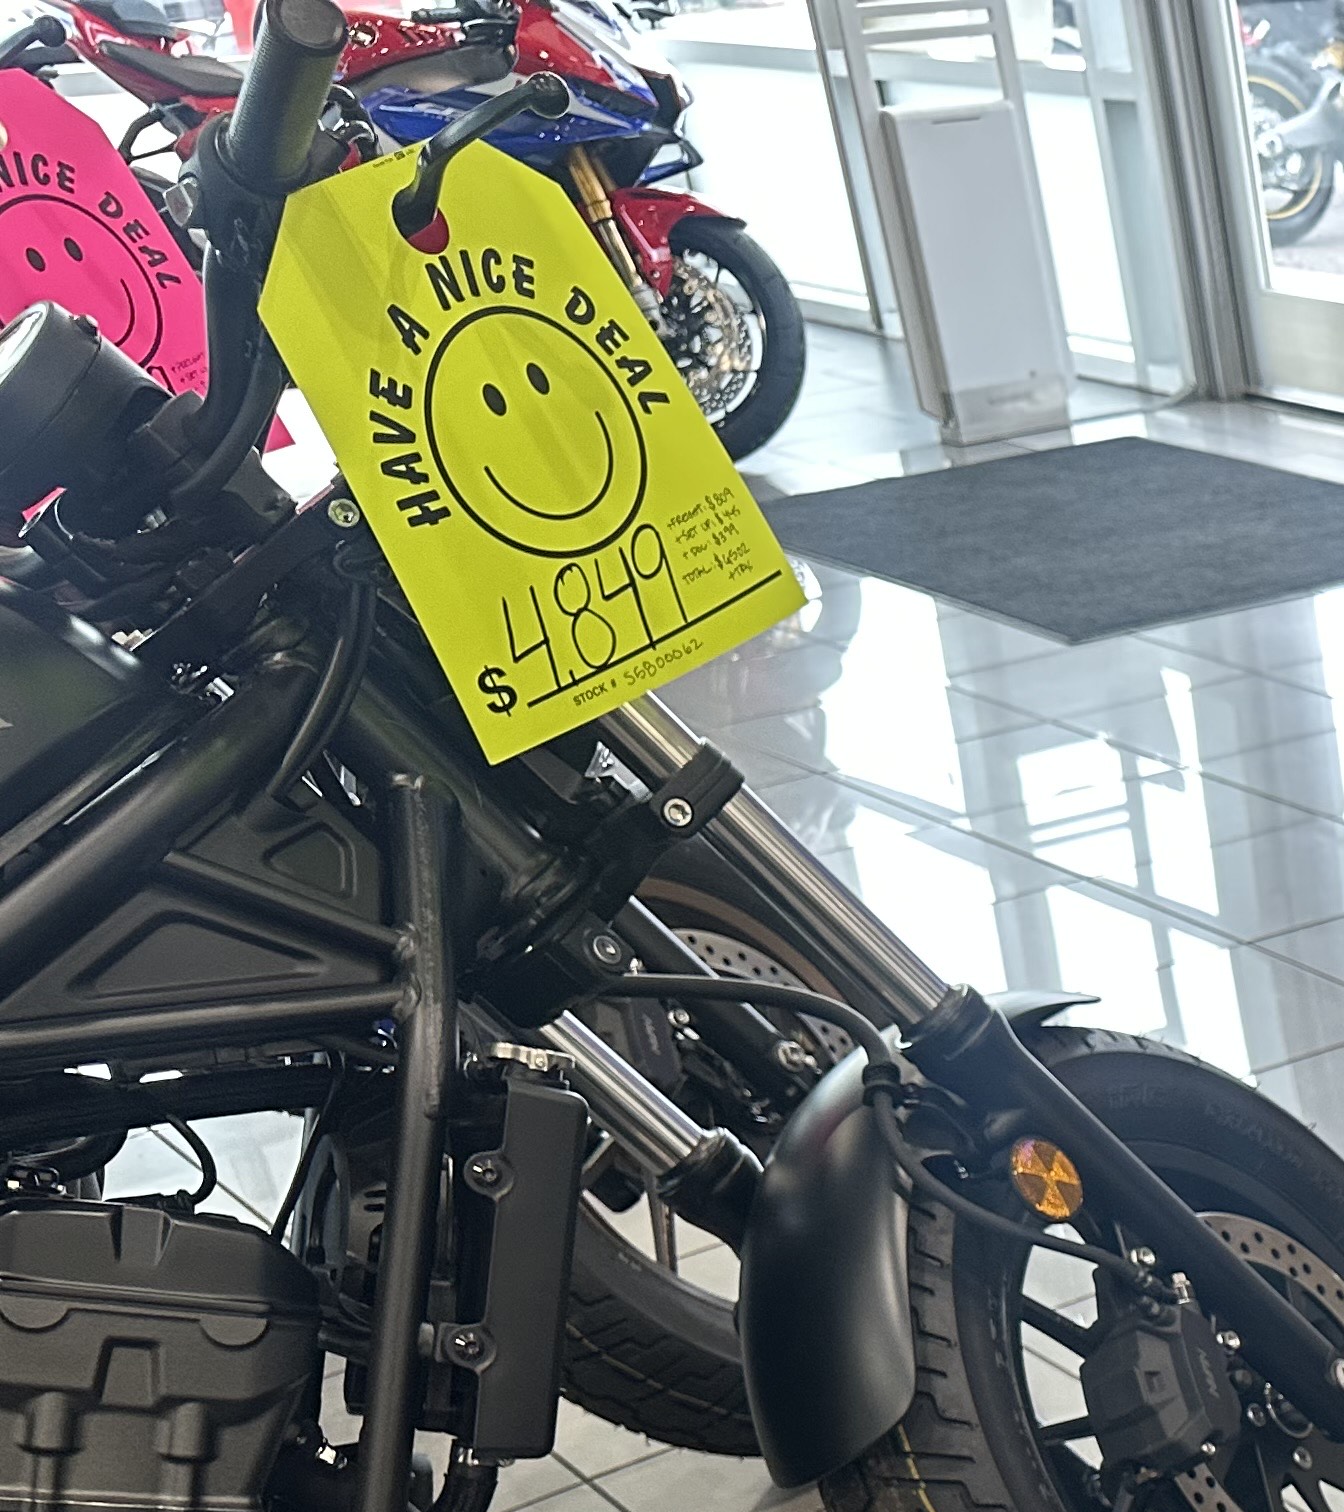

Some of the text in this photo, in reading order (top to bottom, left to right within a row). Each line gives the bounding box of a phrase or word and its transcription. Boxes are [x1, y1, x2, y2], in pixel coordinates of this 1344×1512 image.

[98, 190, 182, 289] DEAL
[369, 248, 670, 527] HAVE A NICE DEAL
[573, 682, 607, 706] STOCK
[611, 678, 617, 688] #
